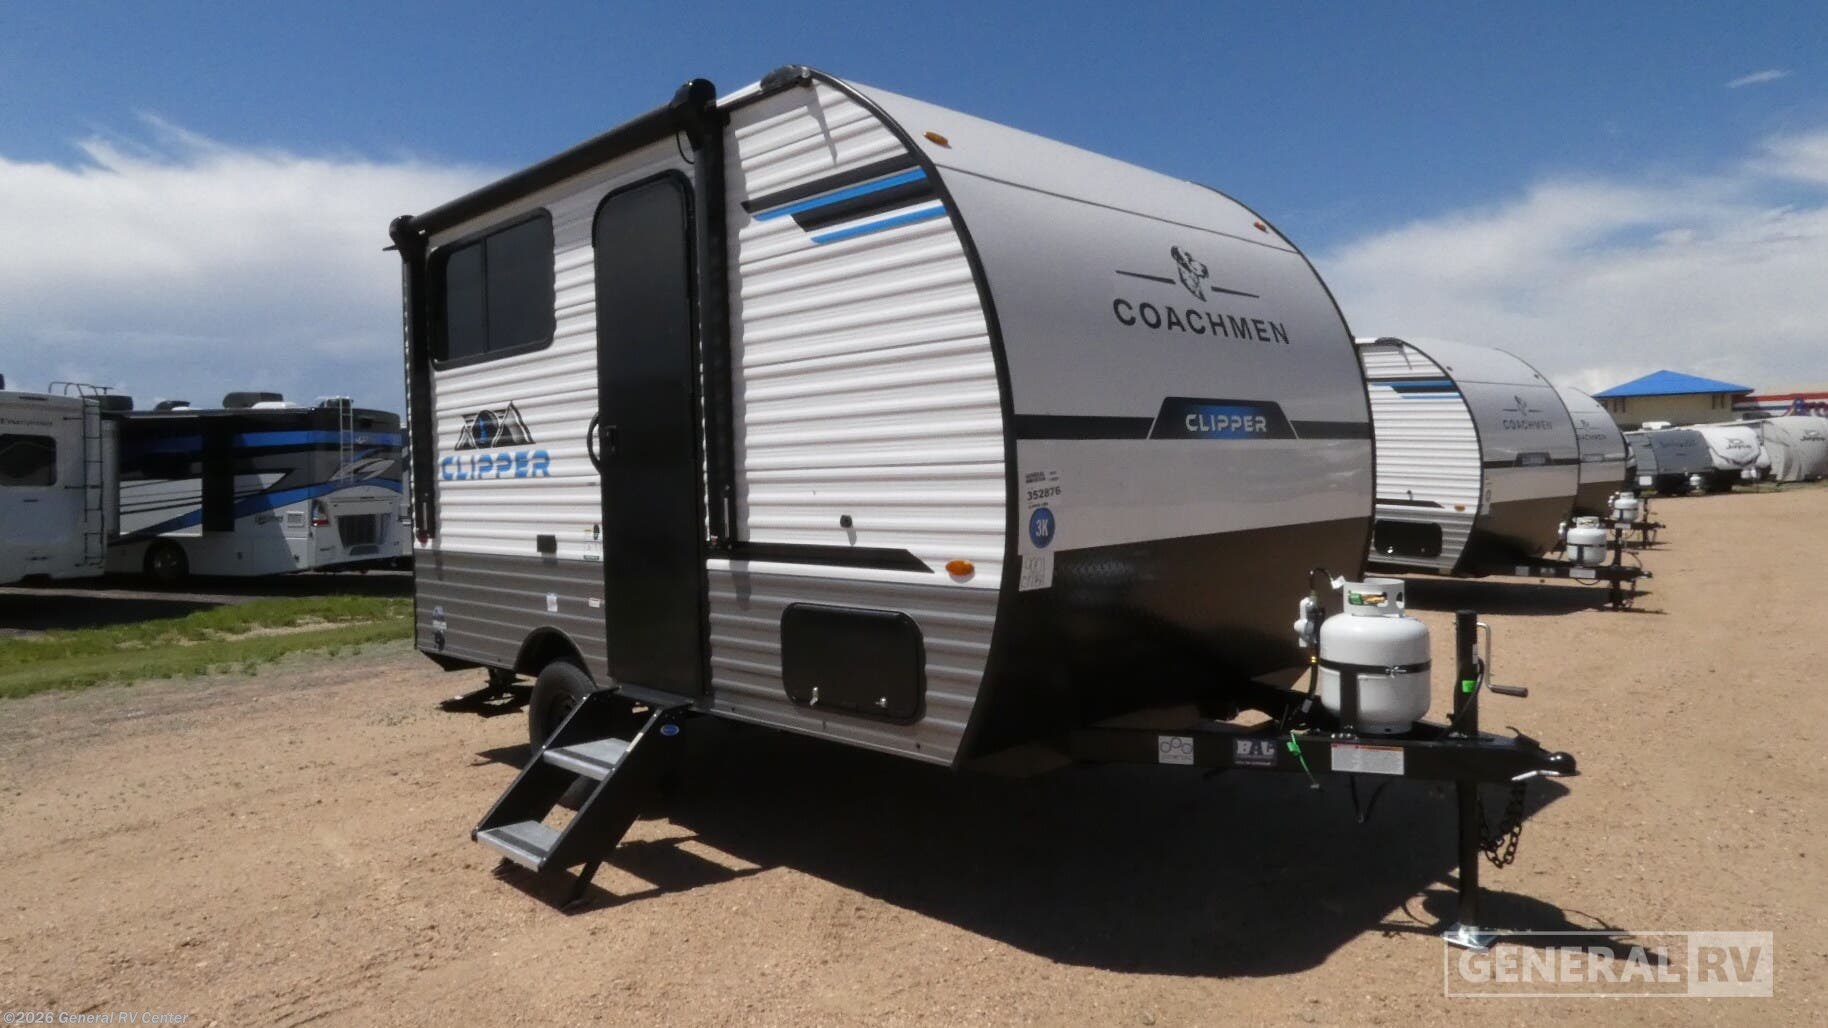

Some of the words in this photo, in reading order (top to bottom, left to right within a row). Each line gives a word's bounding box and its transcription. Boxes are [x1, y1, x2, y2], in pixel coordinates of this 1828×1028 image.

[1112, 298, 1290, 345] COACHMEN
[1185, 413, 1268, 433] CLIPPER
[441, 449, 551, 481] CLIPPER
[1035, 519, 1049, 537] 3K
